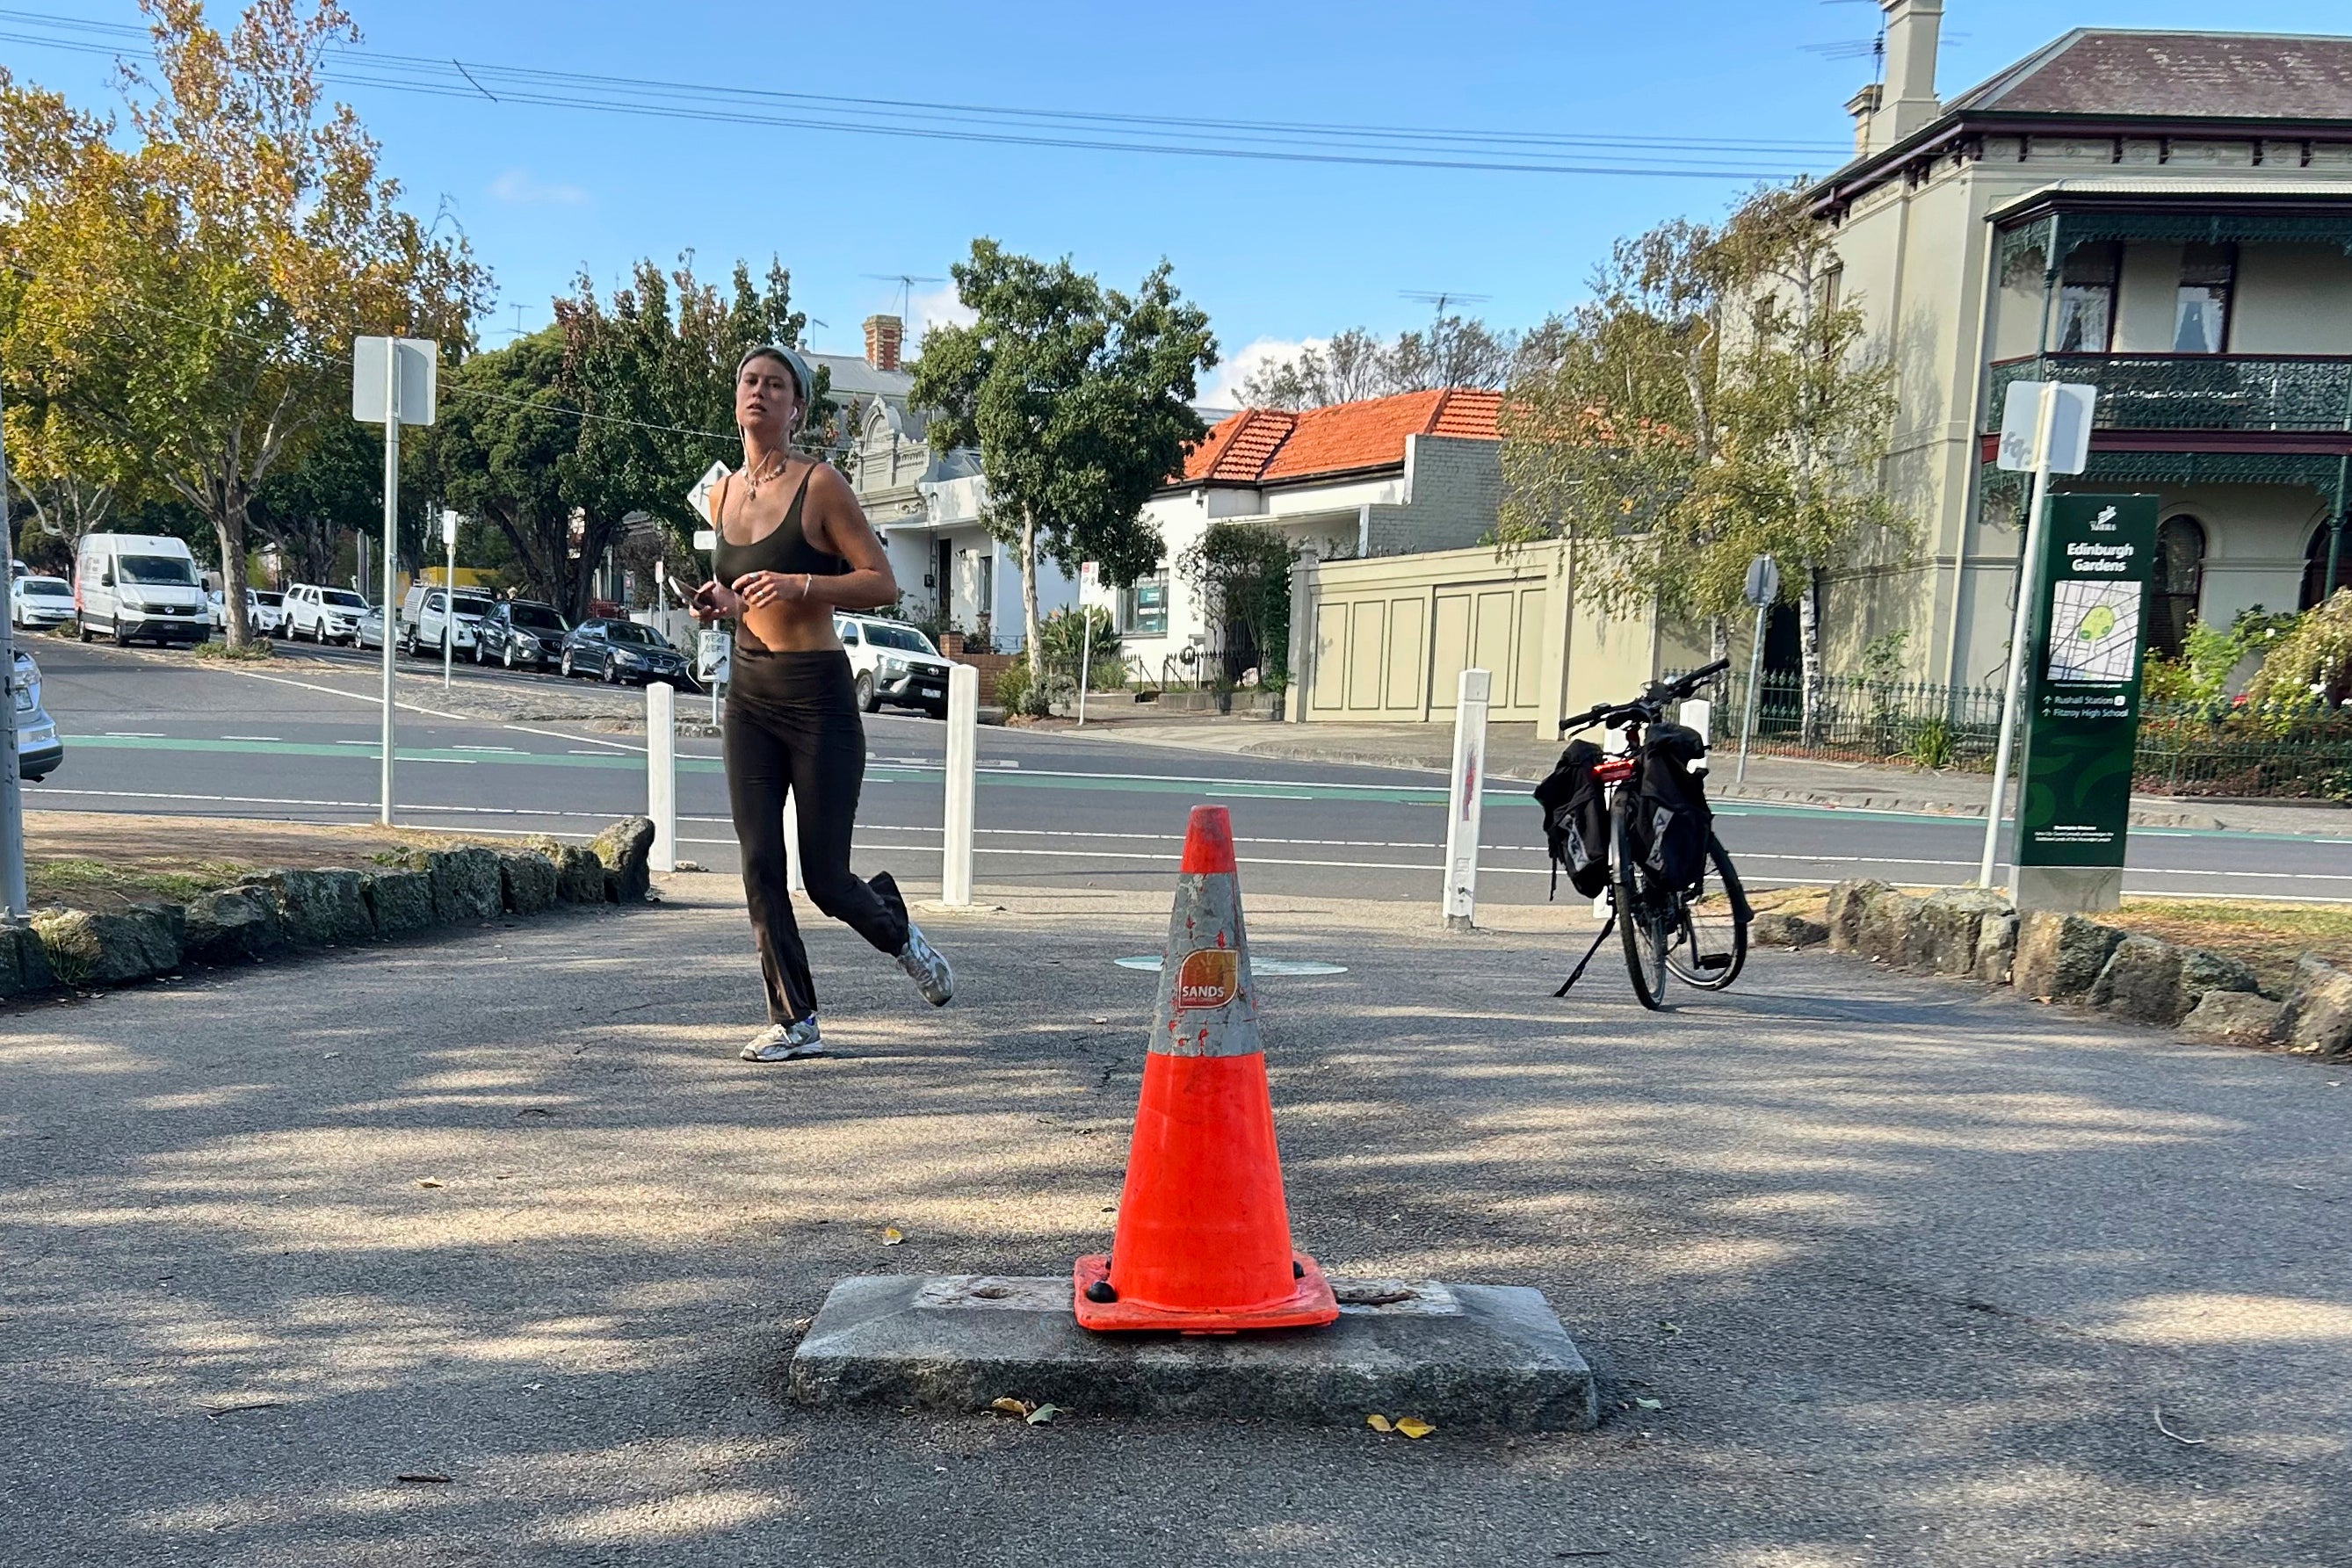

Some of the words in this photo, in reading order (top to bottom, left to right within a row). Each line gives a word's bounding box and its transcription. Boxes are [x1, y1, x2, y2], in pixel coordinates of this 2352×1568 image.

[2066, 542, 2134, 560] Edinburgh
[2072, 559, 2127, 572] Gardens
[2054, 696, 2084, 705] Rushall
[2085, 696, 2114, 705] Station
[2053, 708, 2080, 719] Fitzroy
[2081, 708, 2101, 719] High
[2102, 708, 2129, 718] School
[1182, 985, 1225, 998] SANDS
